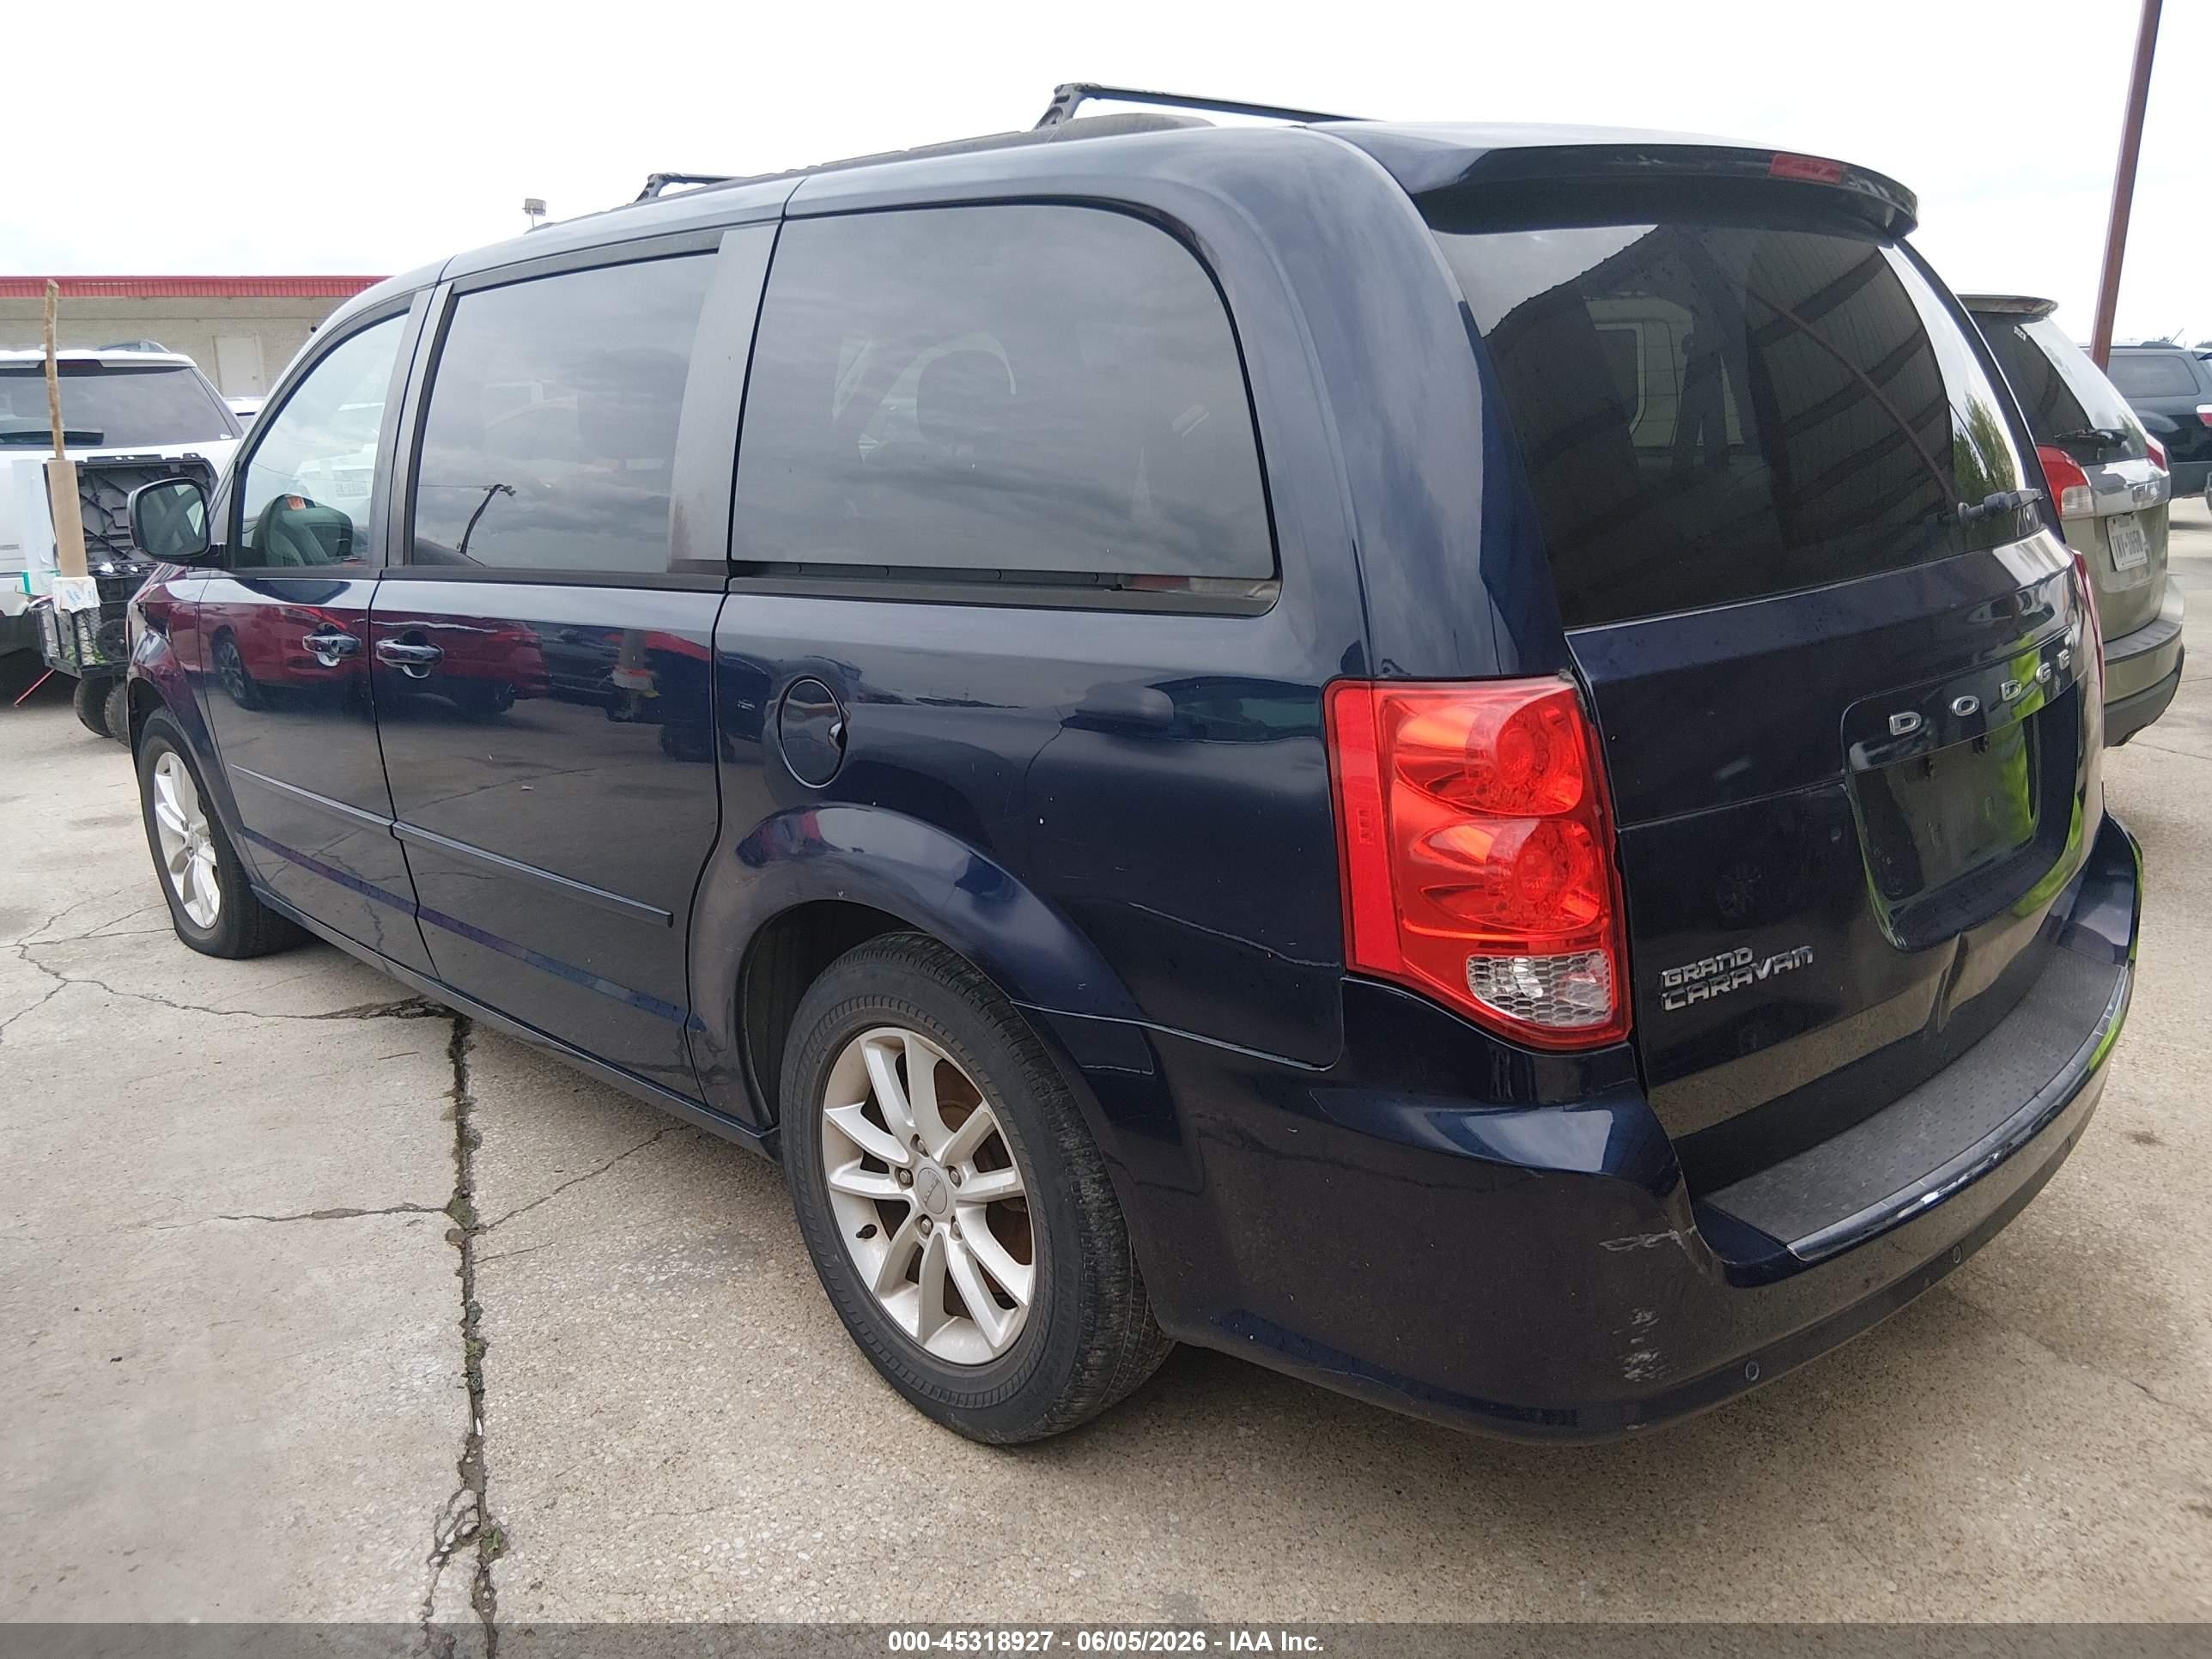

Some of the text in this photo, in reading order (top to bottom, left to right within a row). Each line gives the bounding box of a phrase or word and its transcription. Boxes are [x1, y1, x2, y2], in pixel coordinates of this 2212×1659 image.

[1889, 648, 2071, 736] DODGE
[1660, 946, 1753, 988] GRAND
[1661, 945, 1814, 1012] CARAVAN
